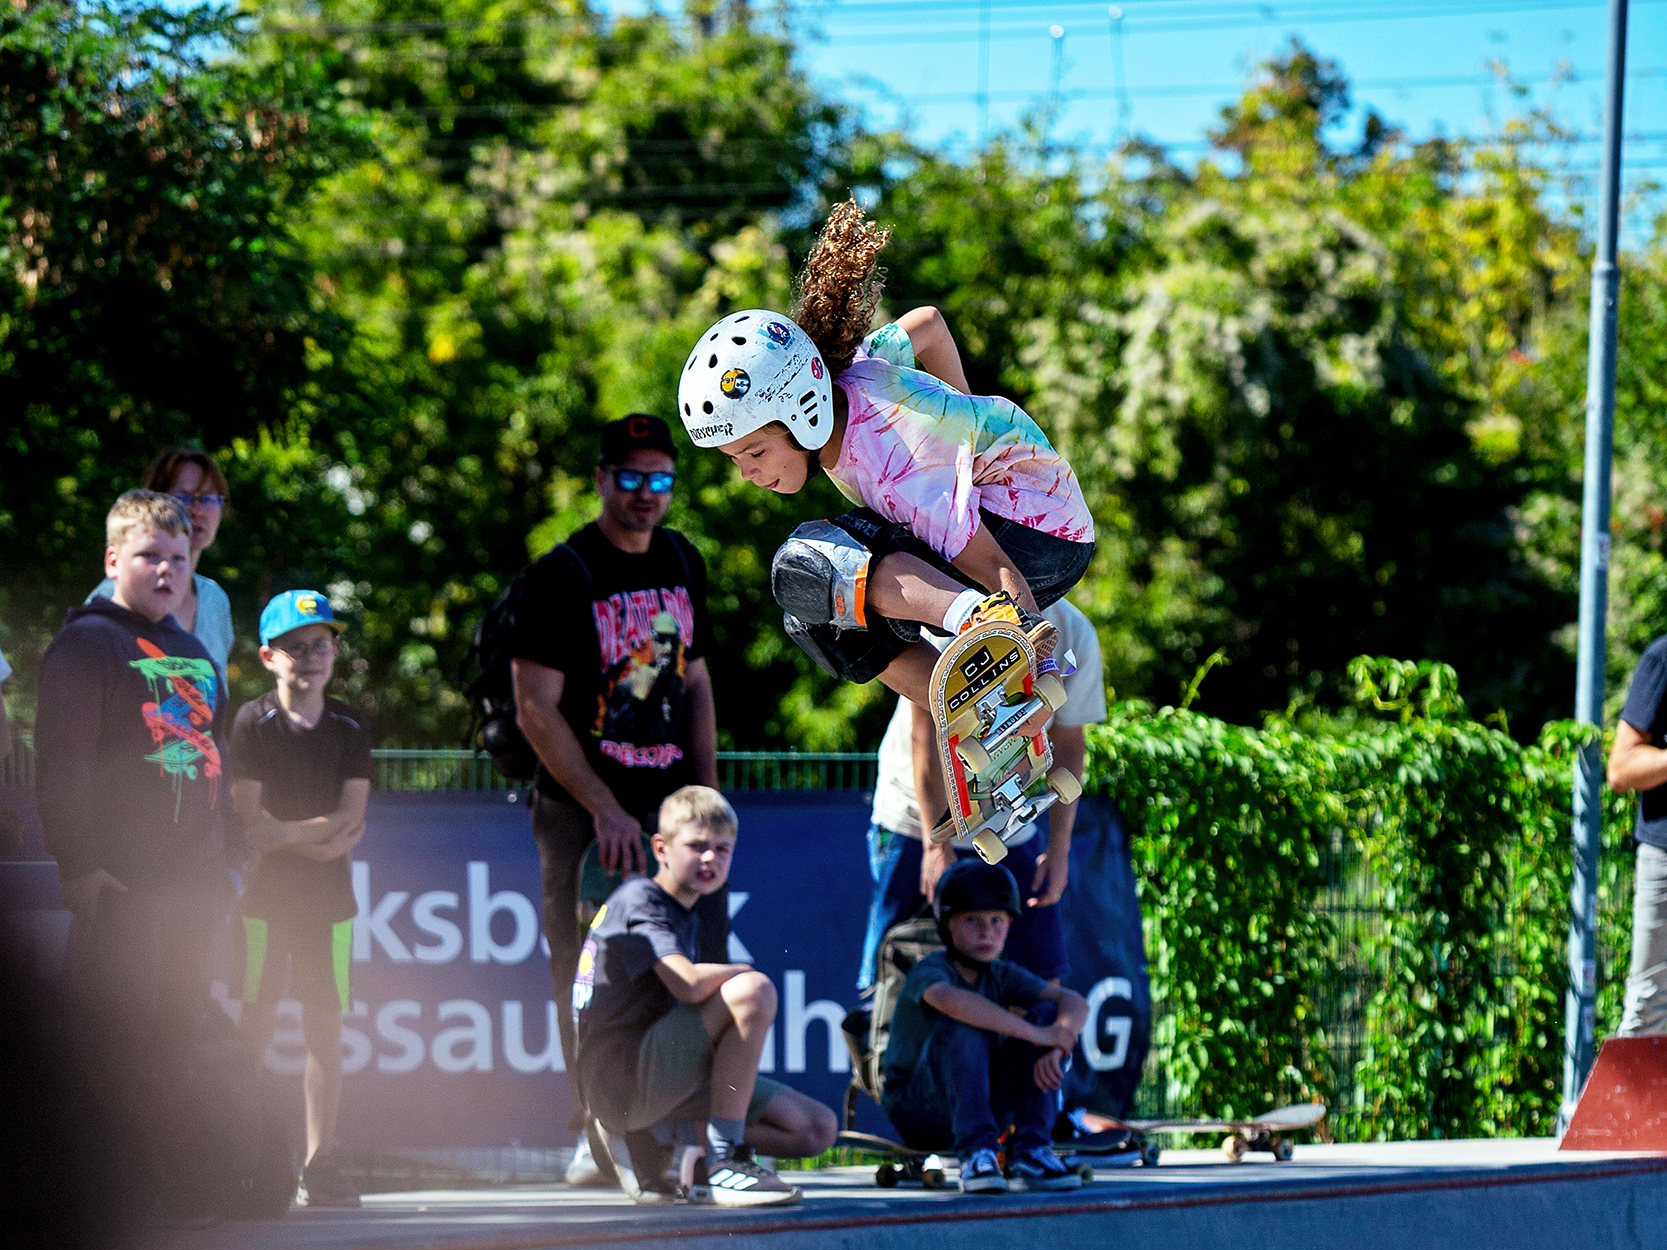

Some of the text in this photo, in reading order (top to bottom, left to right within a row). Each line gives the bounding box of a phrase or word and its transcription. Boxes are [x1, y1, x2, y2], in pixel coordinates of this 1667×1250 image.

[949, 651, 1019, 709] COLLINS
[964, 651, 990, 677] CJ
[1080, 976, 1133, 1072] G
